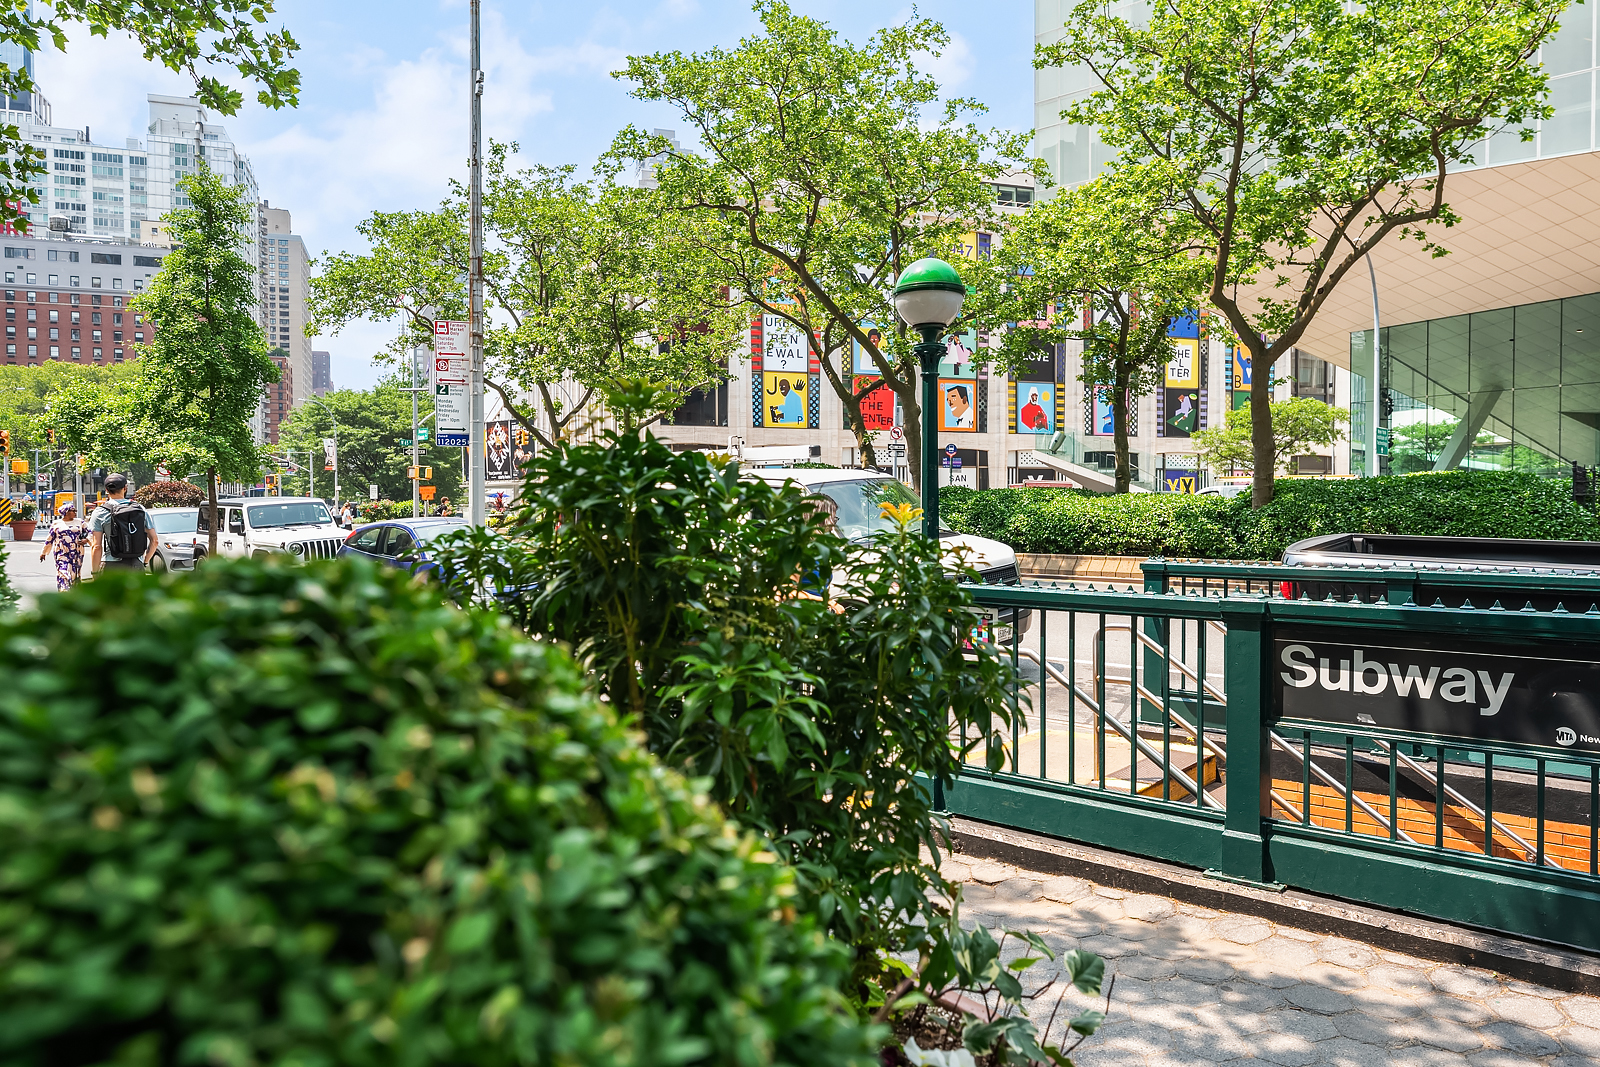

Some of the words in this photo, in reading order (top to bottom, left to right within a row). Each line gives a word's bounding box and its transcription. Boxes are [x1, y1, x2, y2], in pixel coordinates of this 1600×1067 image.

[1170, 368, 1190, 378] TER
[1235, 375, 1242, 388] B
[440, 385, 447, 394] 2
[860, 401, 883, 411] THE
[862, 413, 894, 426] ENTER
[1280, 644, 1515, 716] Subway
